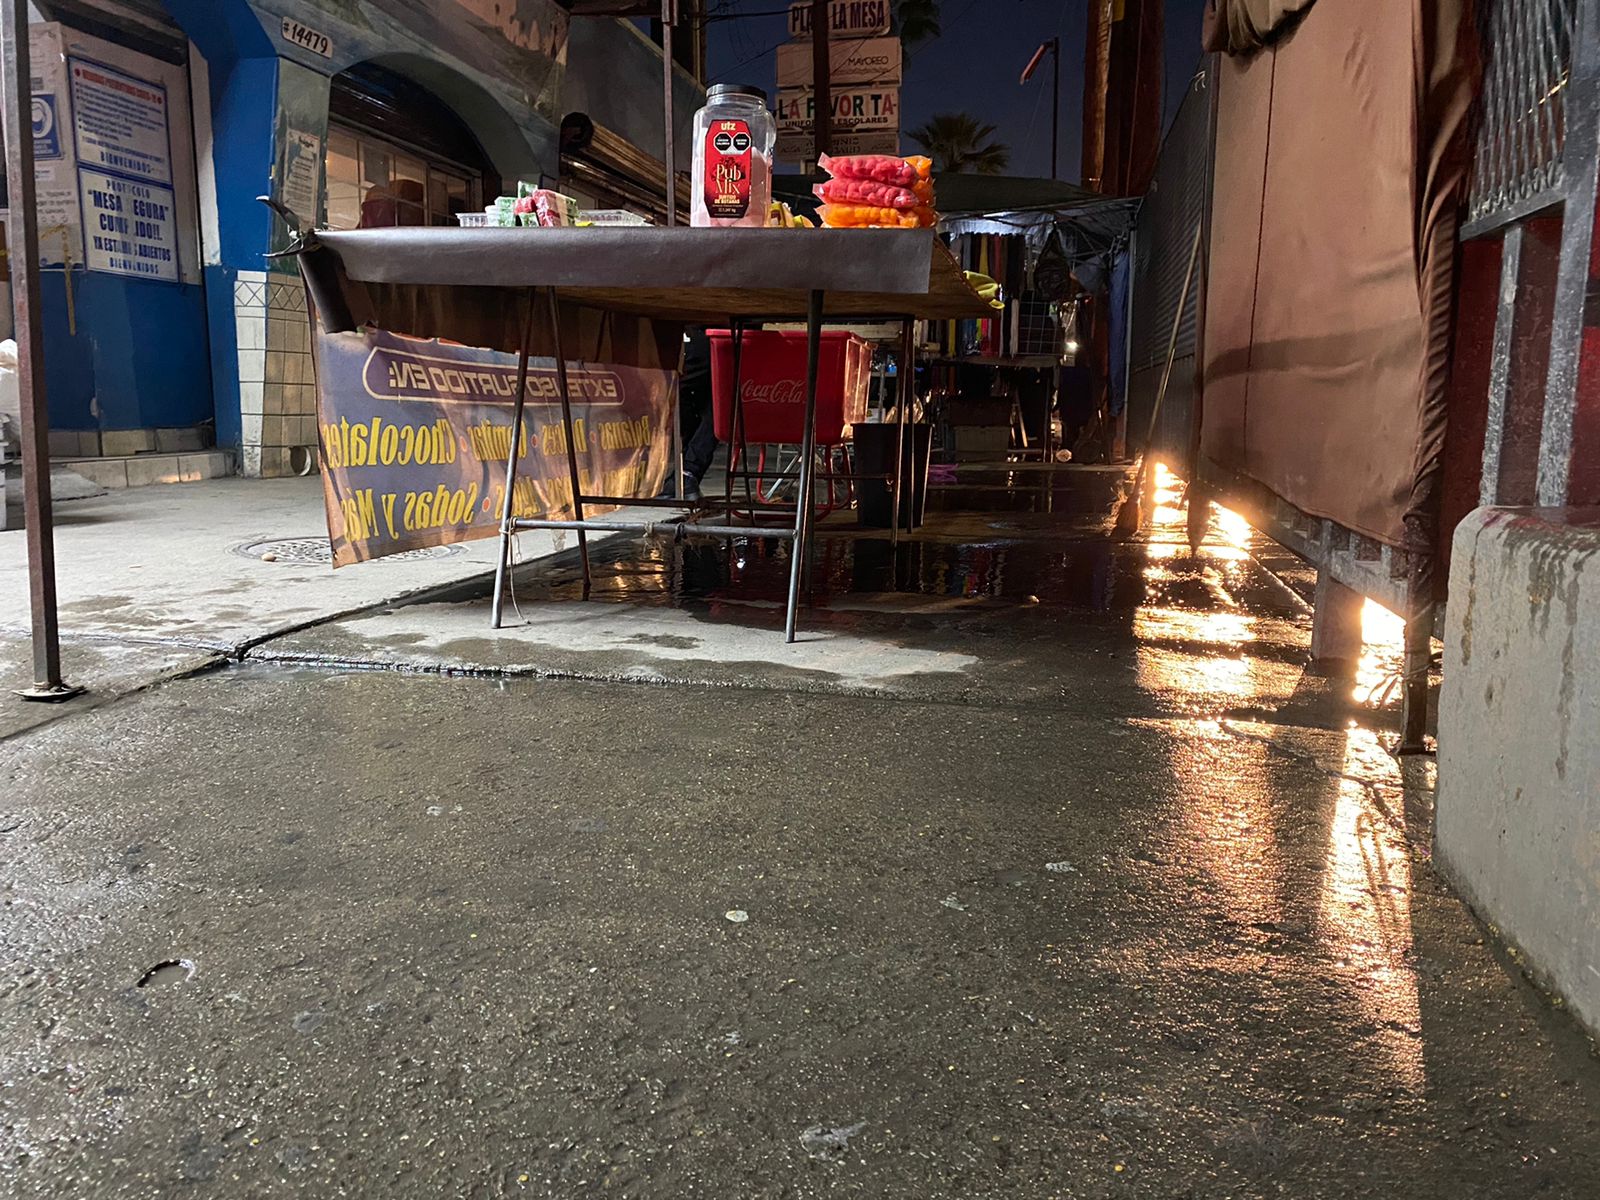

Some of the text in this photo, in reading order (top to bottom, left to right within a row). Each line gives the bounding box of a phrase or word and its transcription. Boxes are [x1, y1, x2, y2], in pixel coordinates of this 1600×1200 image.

[832, 3, 847, 29] LA
[850, 1, 885, 28] MESA
[848, 56, 889, 66] MAYOREO
[779, 98, 800, 120] LA
[838, 116, 889, 126] ESCOLARES
[716, 164, 741, 181] Pub
[106, 180, 150, 199] PROTCOLO
[716, 179, 740, 194] Mix
[133, 199, 169, 222] EGURA"
[105, 239, 138, 256] ESTAMS
